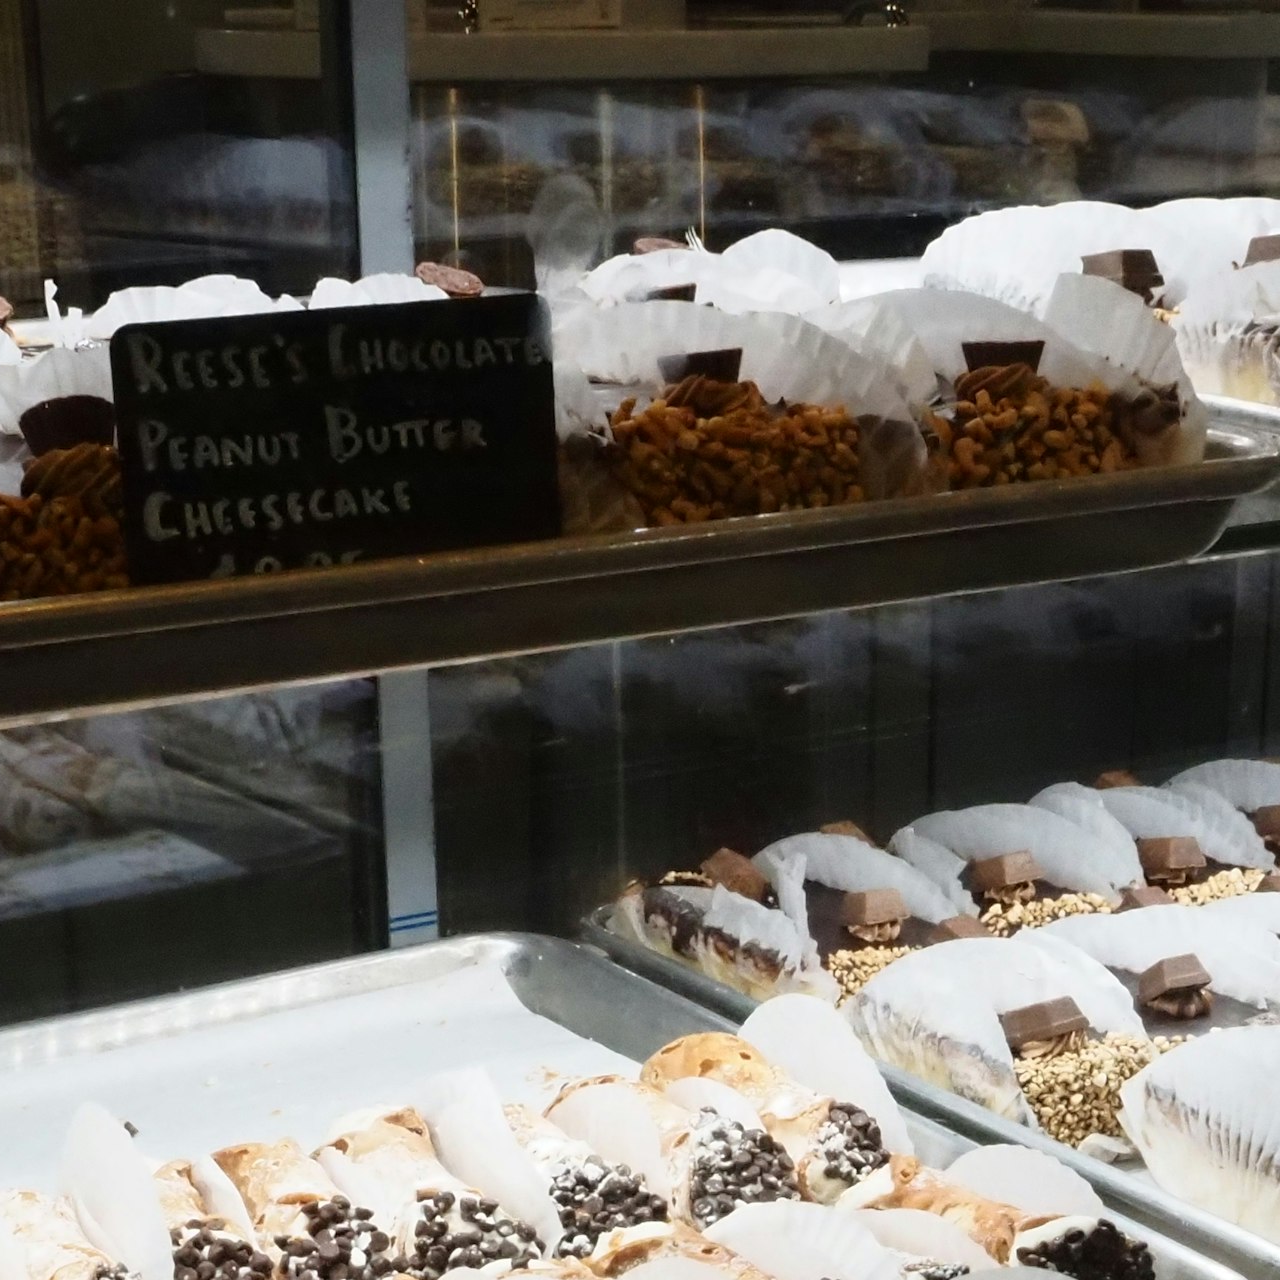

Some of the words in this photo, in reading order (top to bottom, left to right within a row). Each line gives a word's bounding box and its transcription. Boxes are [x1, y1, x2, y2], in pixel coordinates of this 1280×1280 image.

[138, 420, 301, 472] PEANUT
[324, 404, 487, 464] BUTTER
[143, 481, 412, 541] CHEESECAKE
